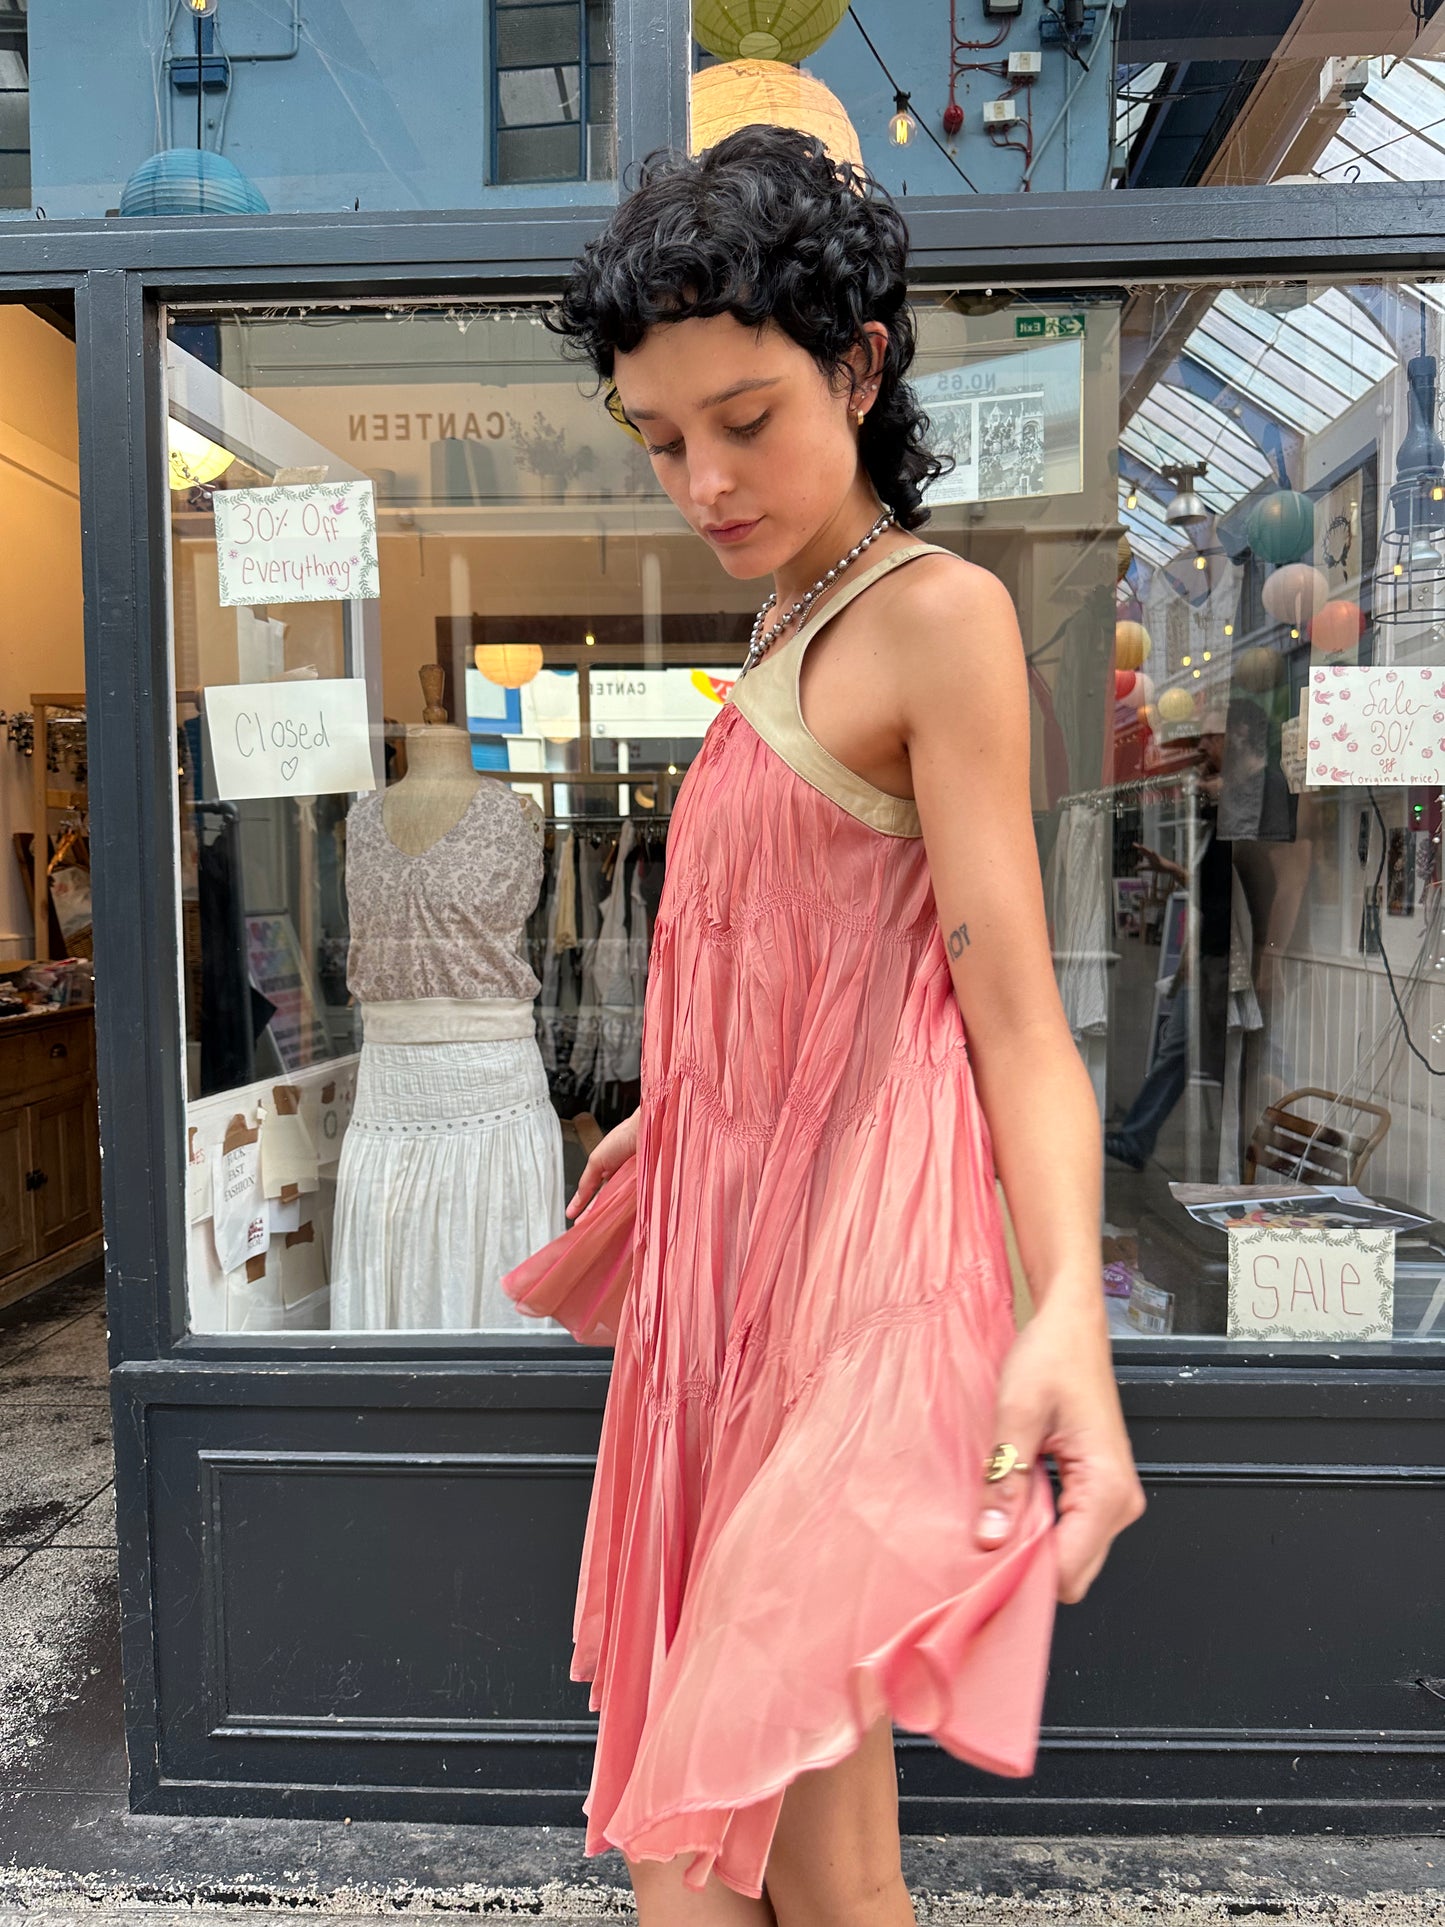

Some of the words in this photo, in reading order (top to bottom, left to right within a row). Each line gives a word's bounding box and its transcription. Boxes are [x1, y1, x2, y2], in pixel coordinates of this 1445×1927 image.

[232, 503, 288, 545] 30%
[242, 554, 351, 592] everything
[1362, 679, 1432, 717] Sale
[235, 710, 330, 758] Closed
[1370, 720, 1416, 756] 30%
[224, 1174, 256, 1202] FASHION
